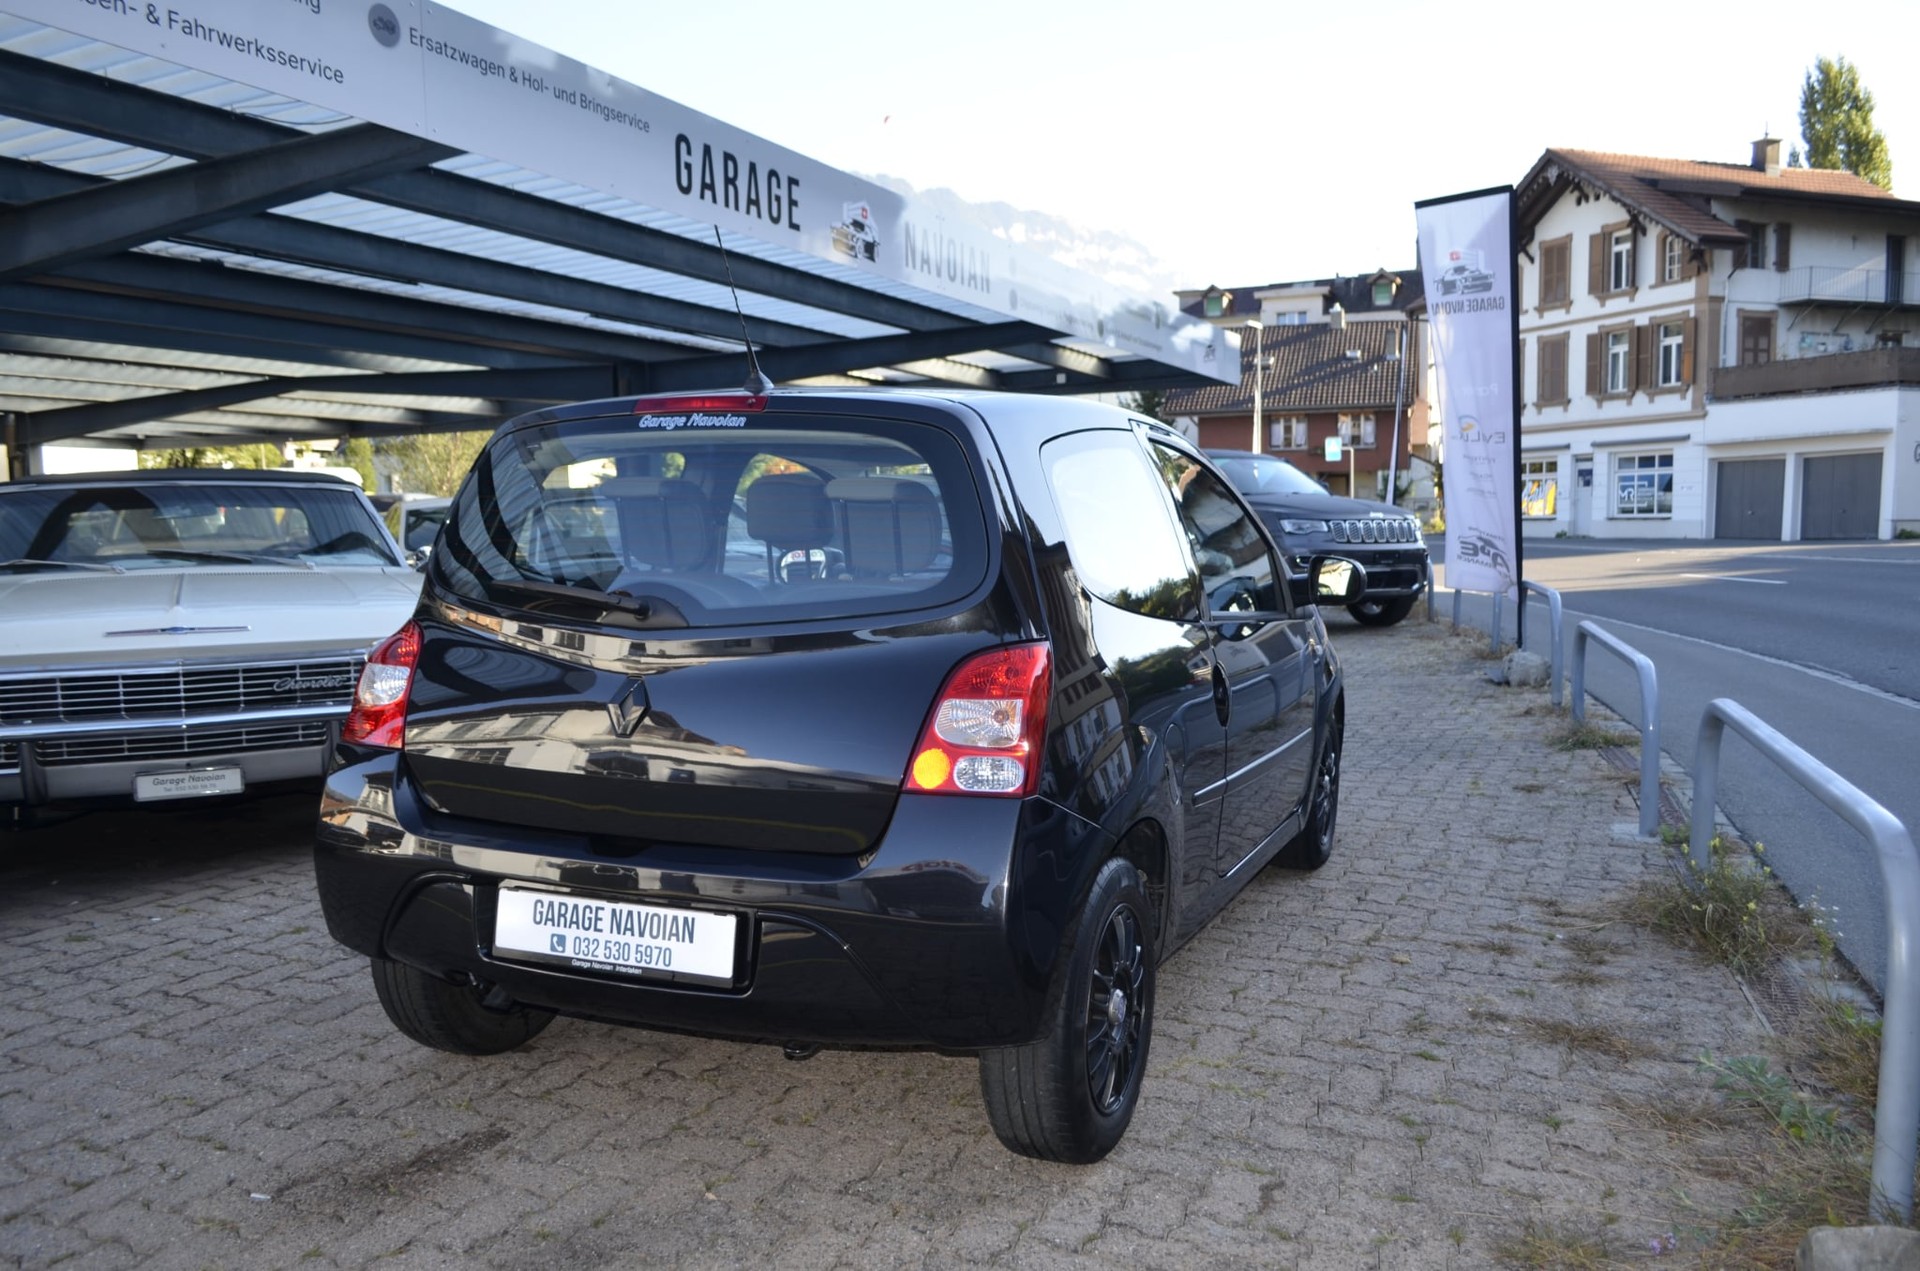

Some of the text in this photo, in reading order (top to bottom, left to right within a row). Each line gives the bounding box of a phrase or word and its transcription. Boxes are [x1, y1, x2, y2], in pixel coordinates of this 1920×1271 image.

[146, 3, 161, 26] &
[167, 9, 345, 84] Fahrwerksservice
[409, 27, 650, 133] Ersatzwagen & Hol- und Bringservice
[675, 133, 991, 294] GARAGE NAVOIAN
[639, 413, 747, 430] Garage Navoian
[152, 777, 186, 786] Garage
[532, 899, 696, 944] GARAGE NAVOIAN
[573, 936, 672, 968] 032 530 5970
